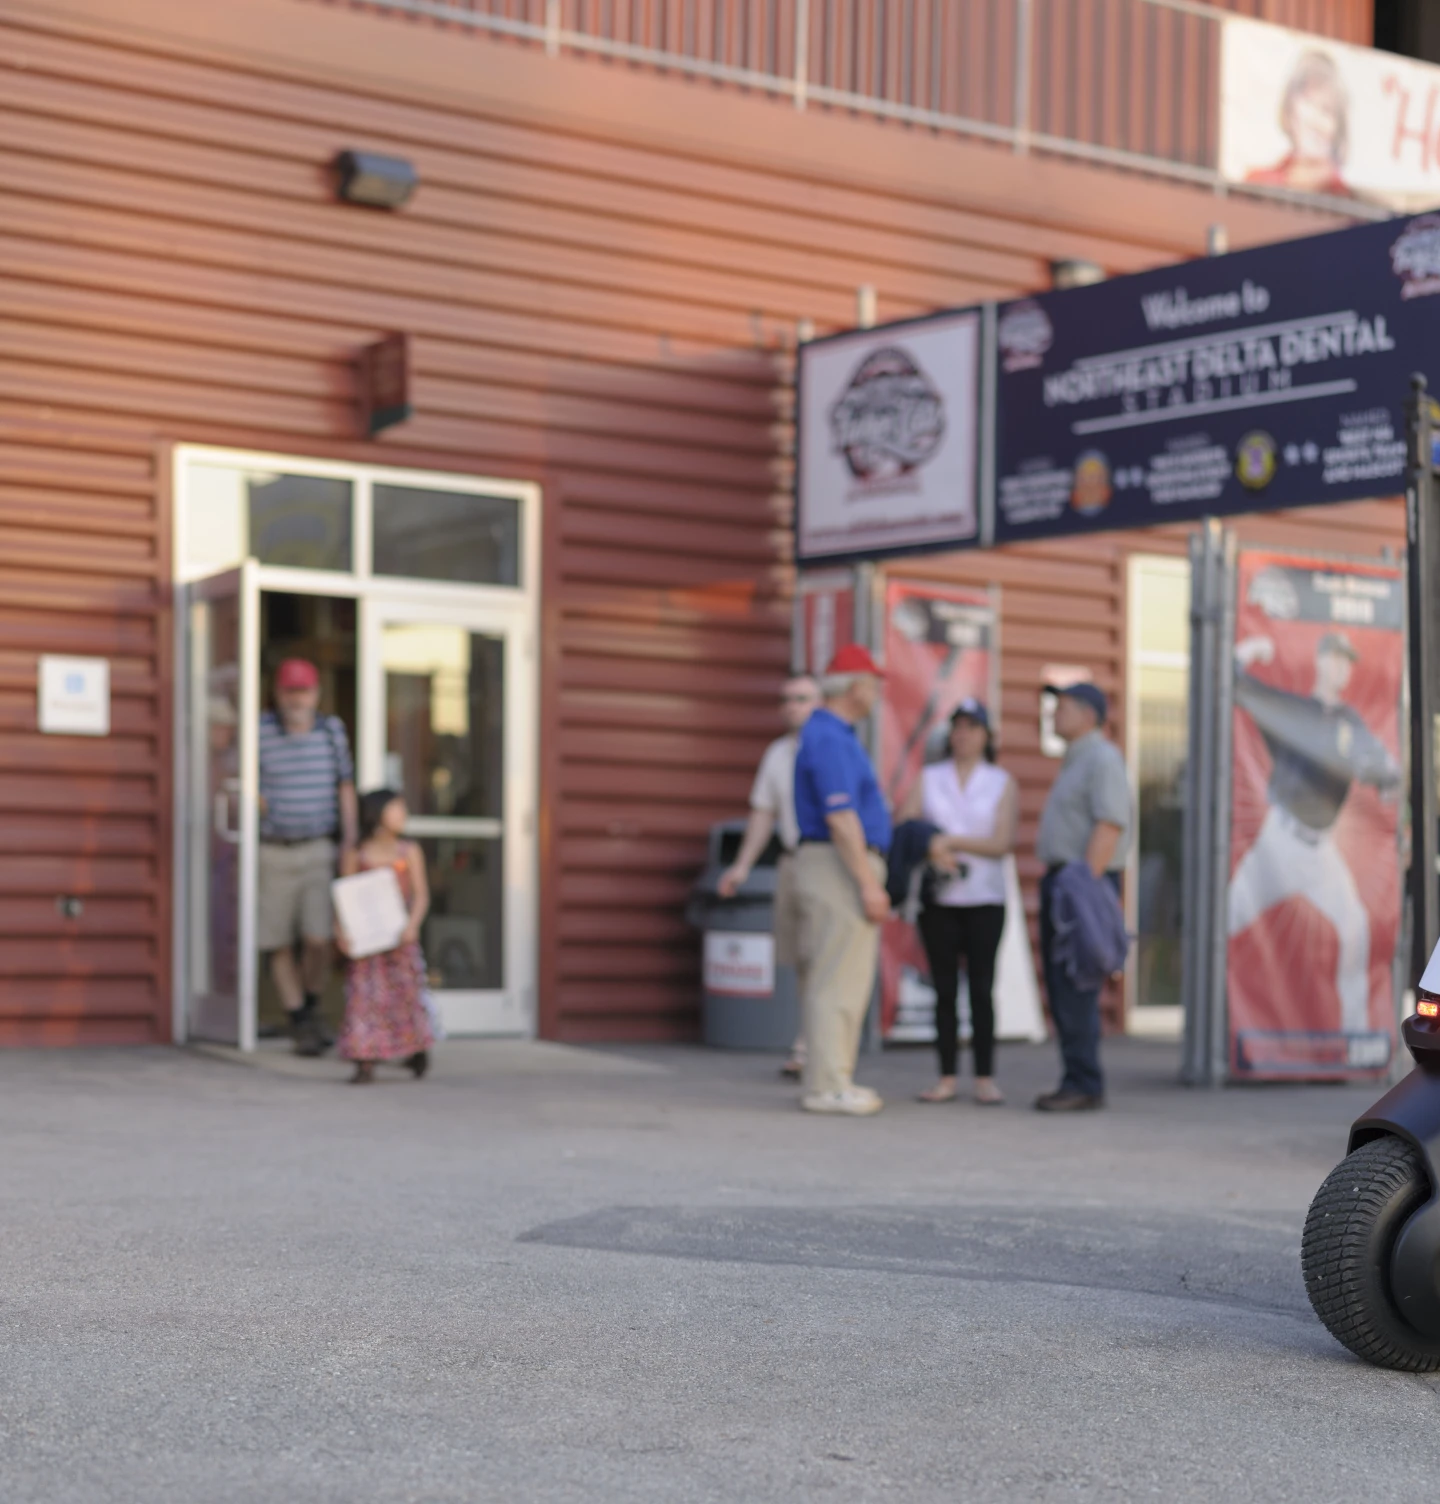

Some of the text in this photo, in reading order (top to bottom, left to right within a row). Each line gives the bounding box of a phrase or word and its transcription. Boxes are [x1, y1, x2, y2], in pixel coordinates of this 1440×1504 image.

[1141, 278, 1270, 330] Welcome to
[1044, 314, 1396, 407] NORTHEAST DELTA DENTAL
